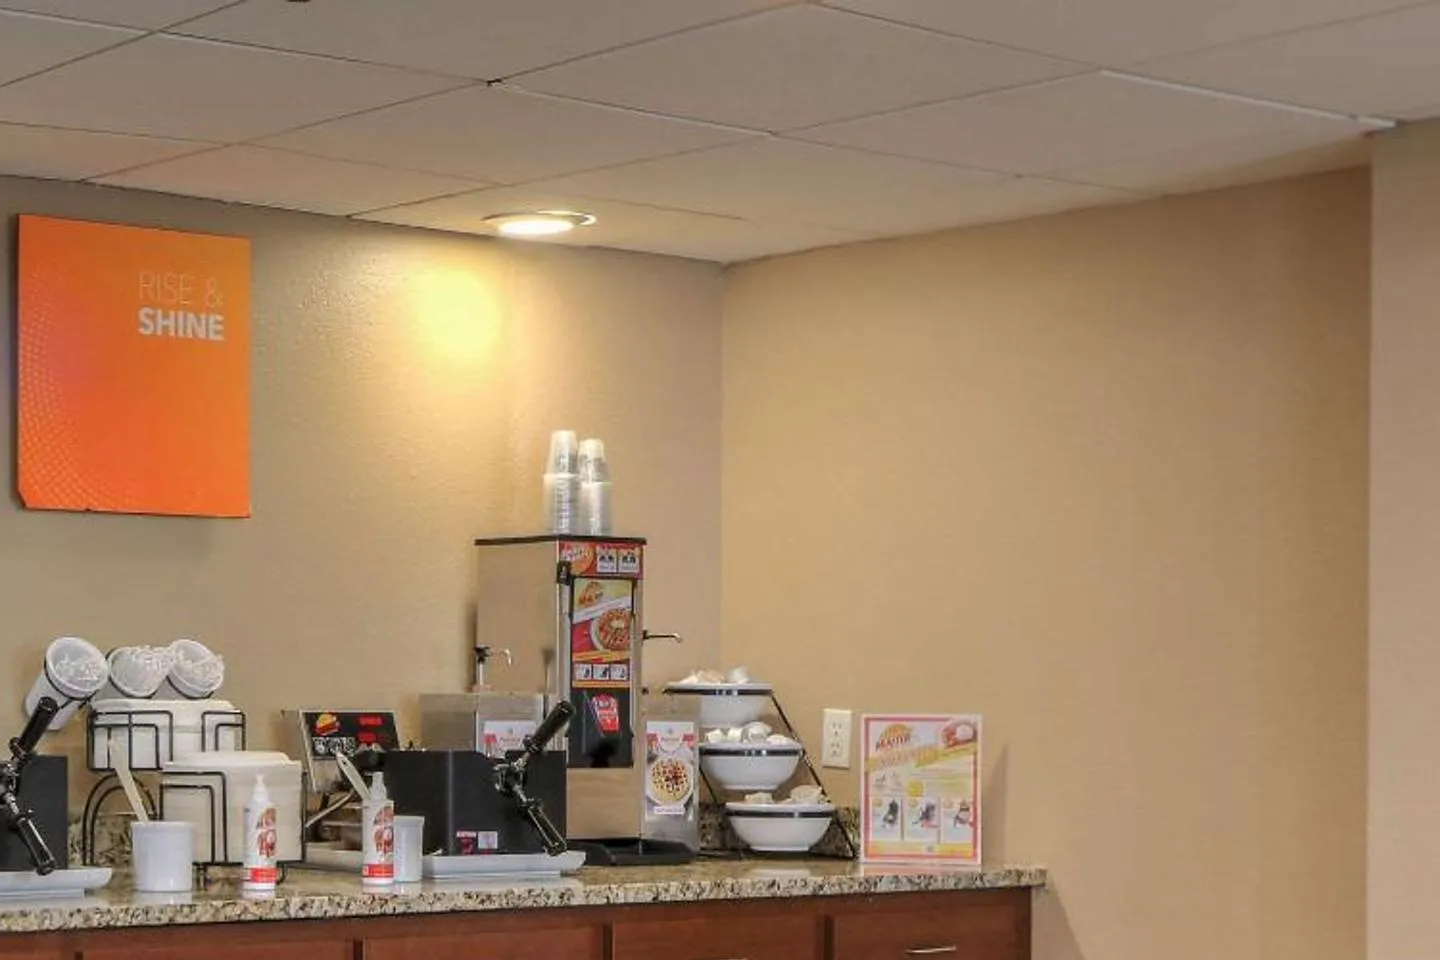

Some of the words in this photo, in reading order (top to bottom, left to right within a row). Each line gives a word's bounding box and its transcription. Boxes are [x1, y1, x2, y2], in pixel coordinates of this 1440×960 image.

[139, 269, 195, 305] RISE
[202, 275, 223, 308] &
[138, 306, 225, 341] SHINE
